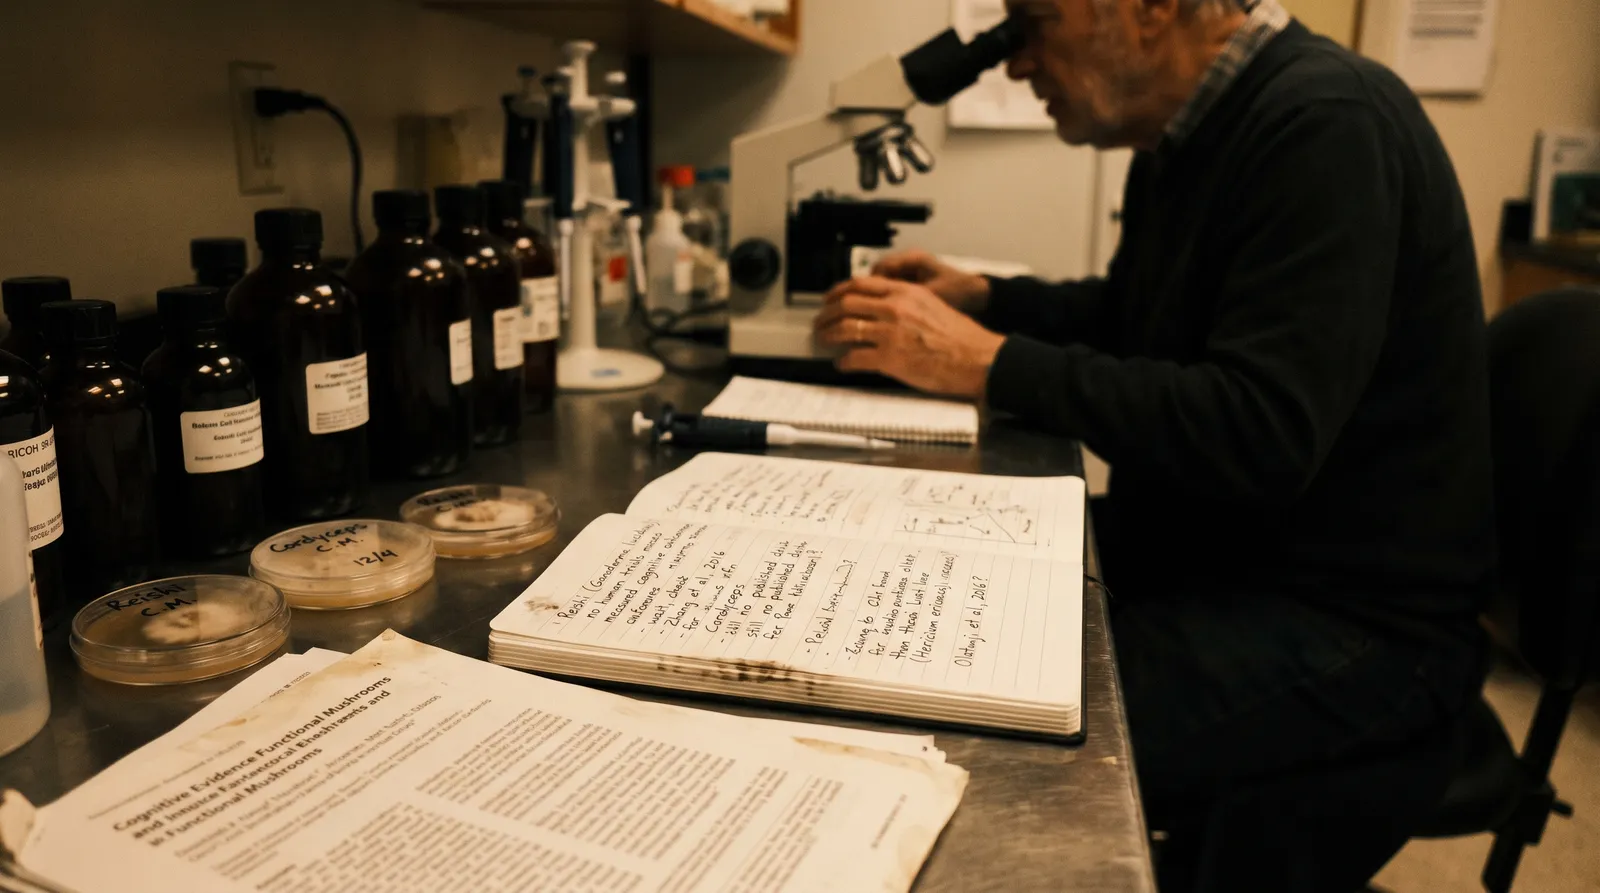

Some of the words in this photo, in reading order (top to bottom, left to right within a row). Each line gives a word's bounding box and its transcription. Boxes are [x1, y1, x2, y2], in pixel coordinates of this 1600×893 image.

[270, 524, 367, 552] Cordyceps
[316, 537, 364, 552] C.M.
[353, 549, 398, 566] 12/4
[587, 609, 600, 619] no
[599, 580, 625, 605] human
[664, 601, 699, 627] Zhang
[688, 588, 699, 598] et
[704, 550, 725, 570] 2016
[557, 595, 590, 619] Reishi
[604, 589, 638, 623] measured
[705, 584, 745, 632] Cordyceps
[741, 604, 752, 616] no
[763, 604, 773, 615] no
[964, 619, 979, 629] et
[113, 791, 190, 831] Cognitive
[190, 756, 257, 793] Evidence
[255, 714, 325, 757] Functional
[322, 676, 391, 718] Mushrooms
[133, 819, 164, 840] and
[368, 690, 391, 706] and
[164, 792, 247, 838] Functional
[244, 747, 322, 795] Mushrooms
